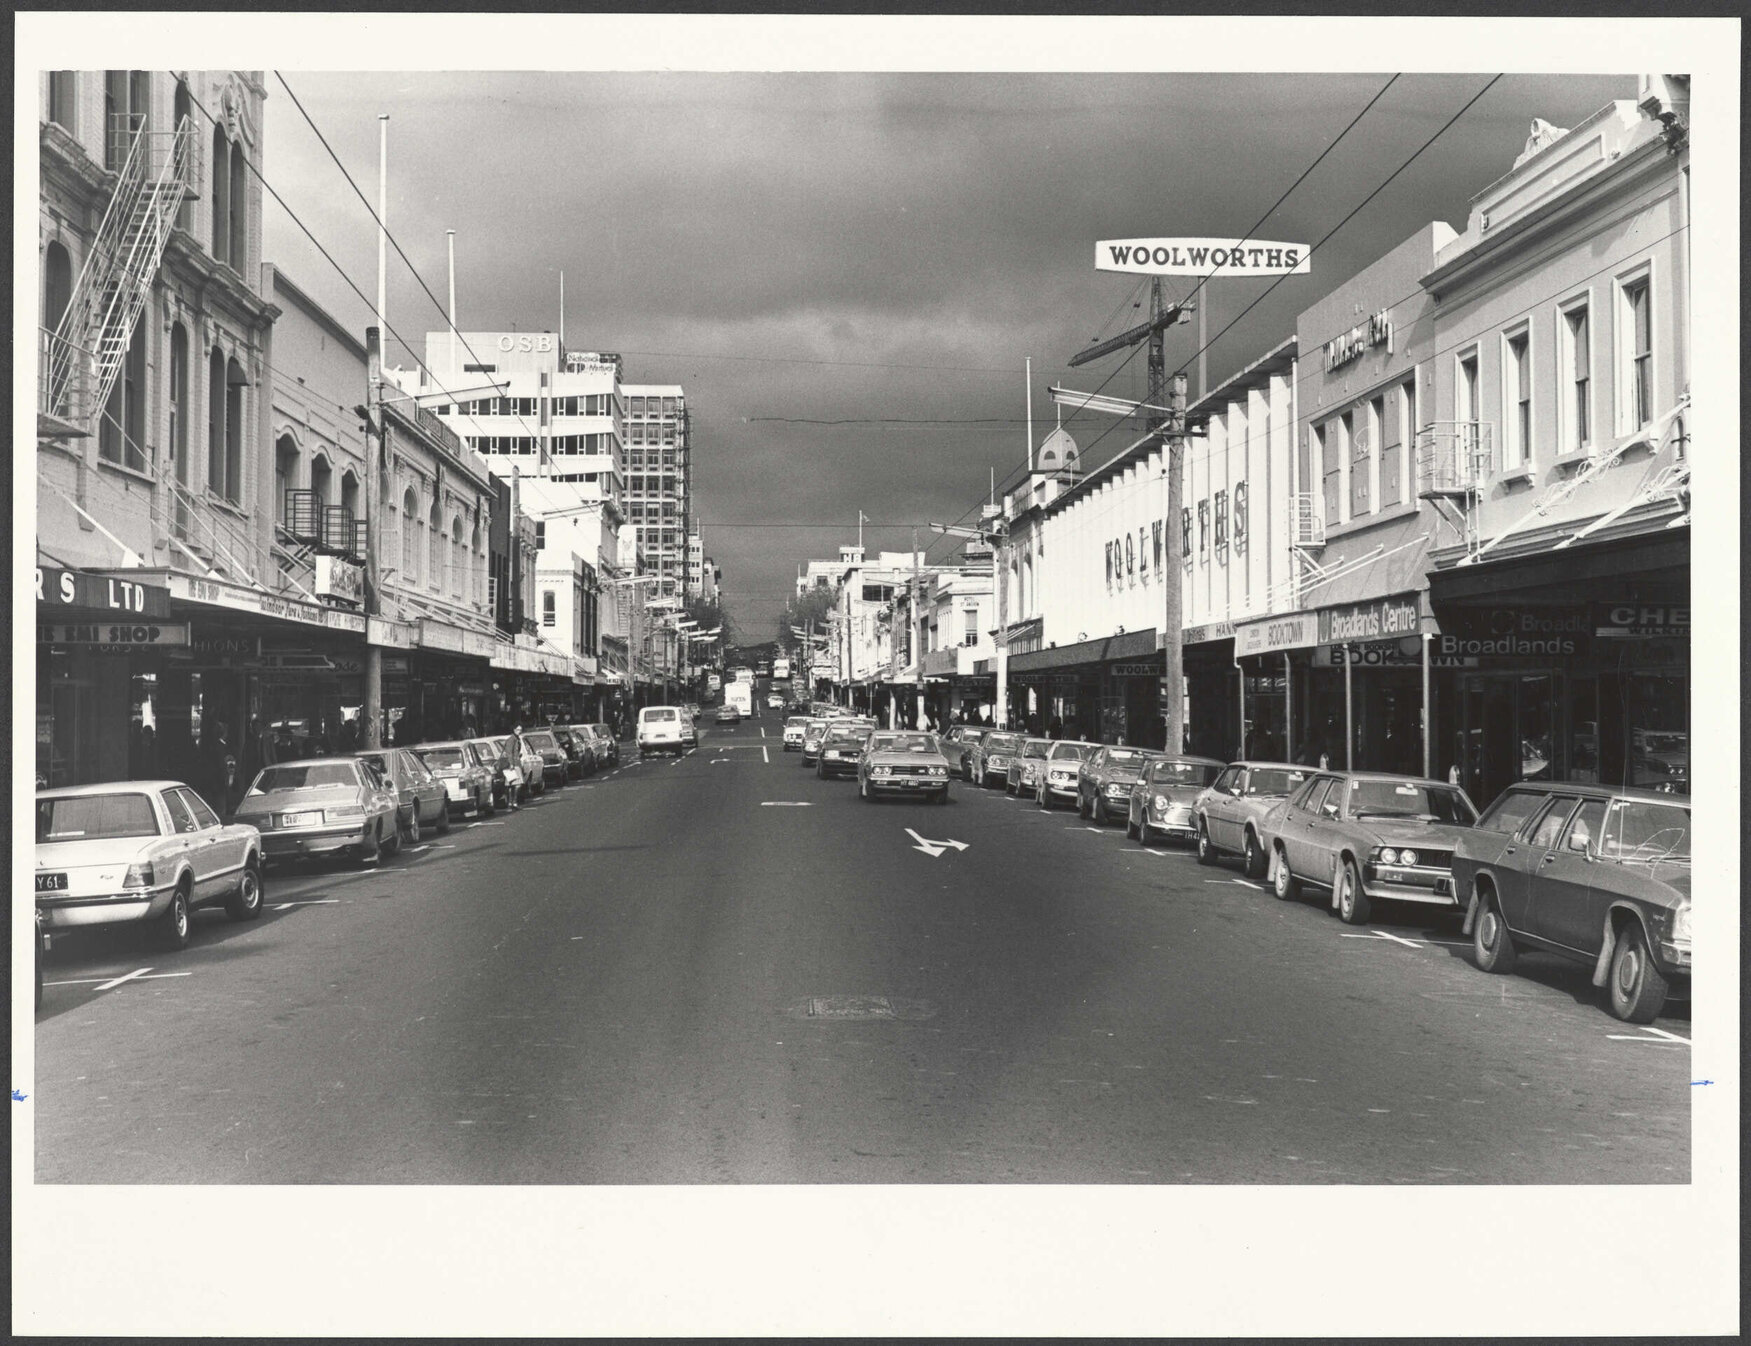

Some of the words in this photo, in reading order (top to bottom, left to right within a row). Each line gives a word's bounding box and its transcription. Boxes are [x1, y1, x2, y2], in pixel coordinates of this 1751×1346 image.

[1109, 245, 1299, 268] WOOLWORTHS
[499, 336, 552, 353] OSB
[1105, 481, 1247, 584] WOOLWRTHS
[108, 578, 145, 613] LTD
[1268, 620, 1303, 647] BOOKTOWN
[1331, 604, 1379, 640] Broadlands
[1381, 602, 1416, 633] Centre
[109, 626, 160, 643] SHOP
[1441, 635, 1576, 656] Broadlands
